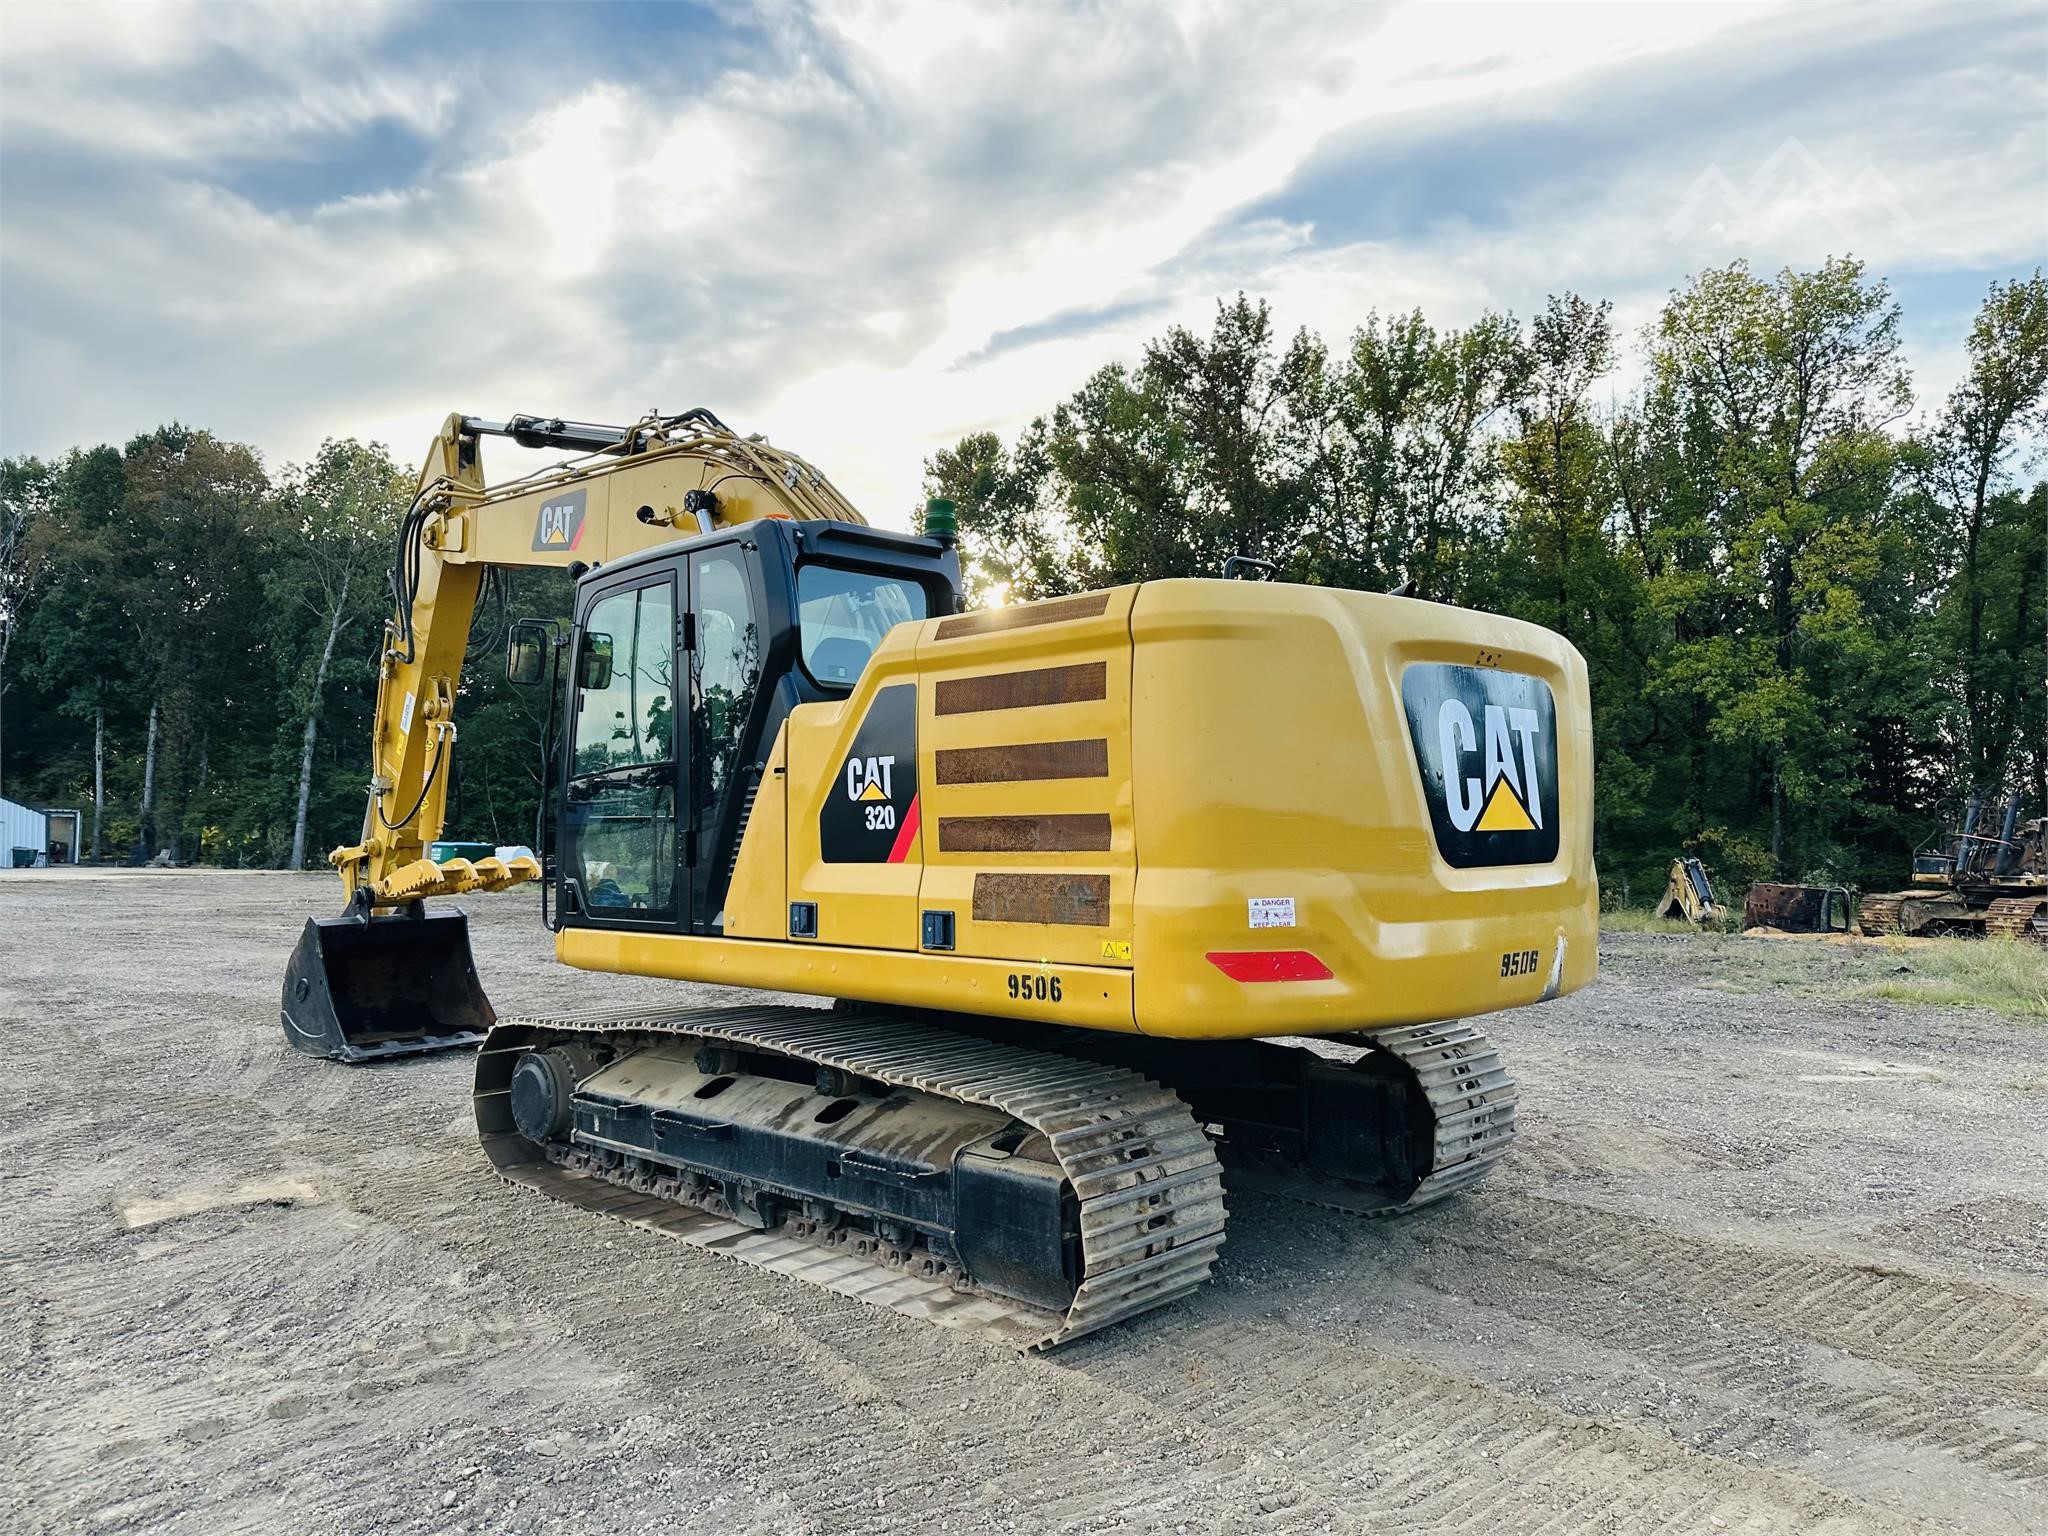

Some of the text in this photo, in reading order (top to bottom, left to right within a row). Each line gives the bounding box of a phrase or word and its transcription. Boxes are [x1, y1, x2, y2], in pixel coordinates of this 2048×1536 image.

[541, 505, 574, 544] CAT
[847, 755, 895, 801] CAT
[1438, 698, 1544, 832] CAT
[865, 805, 896, 831] 320
[1500, 950, 1539, 977] 9506
[1008, 974, 1062, 1002] 9506
